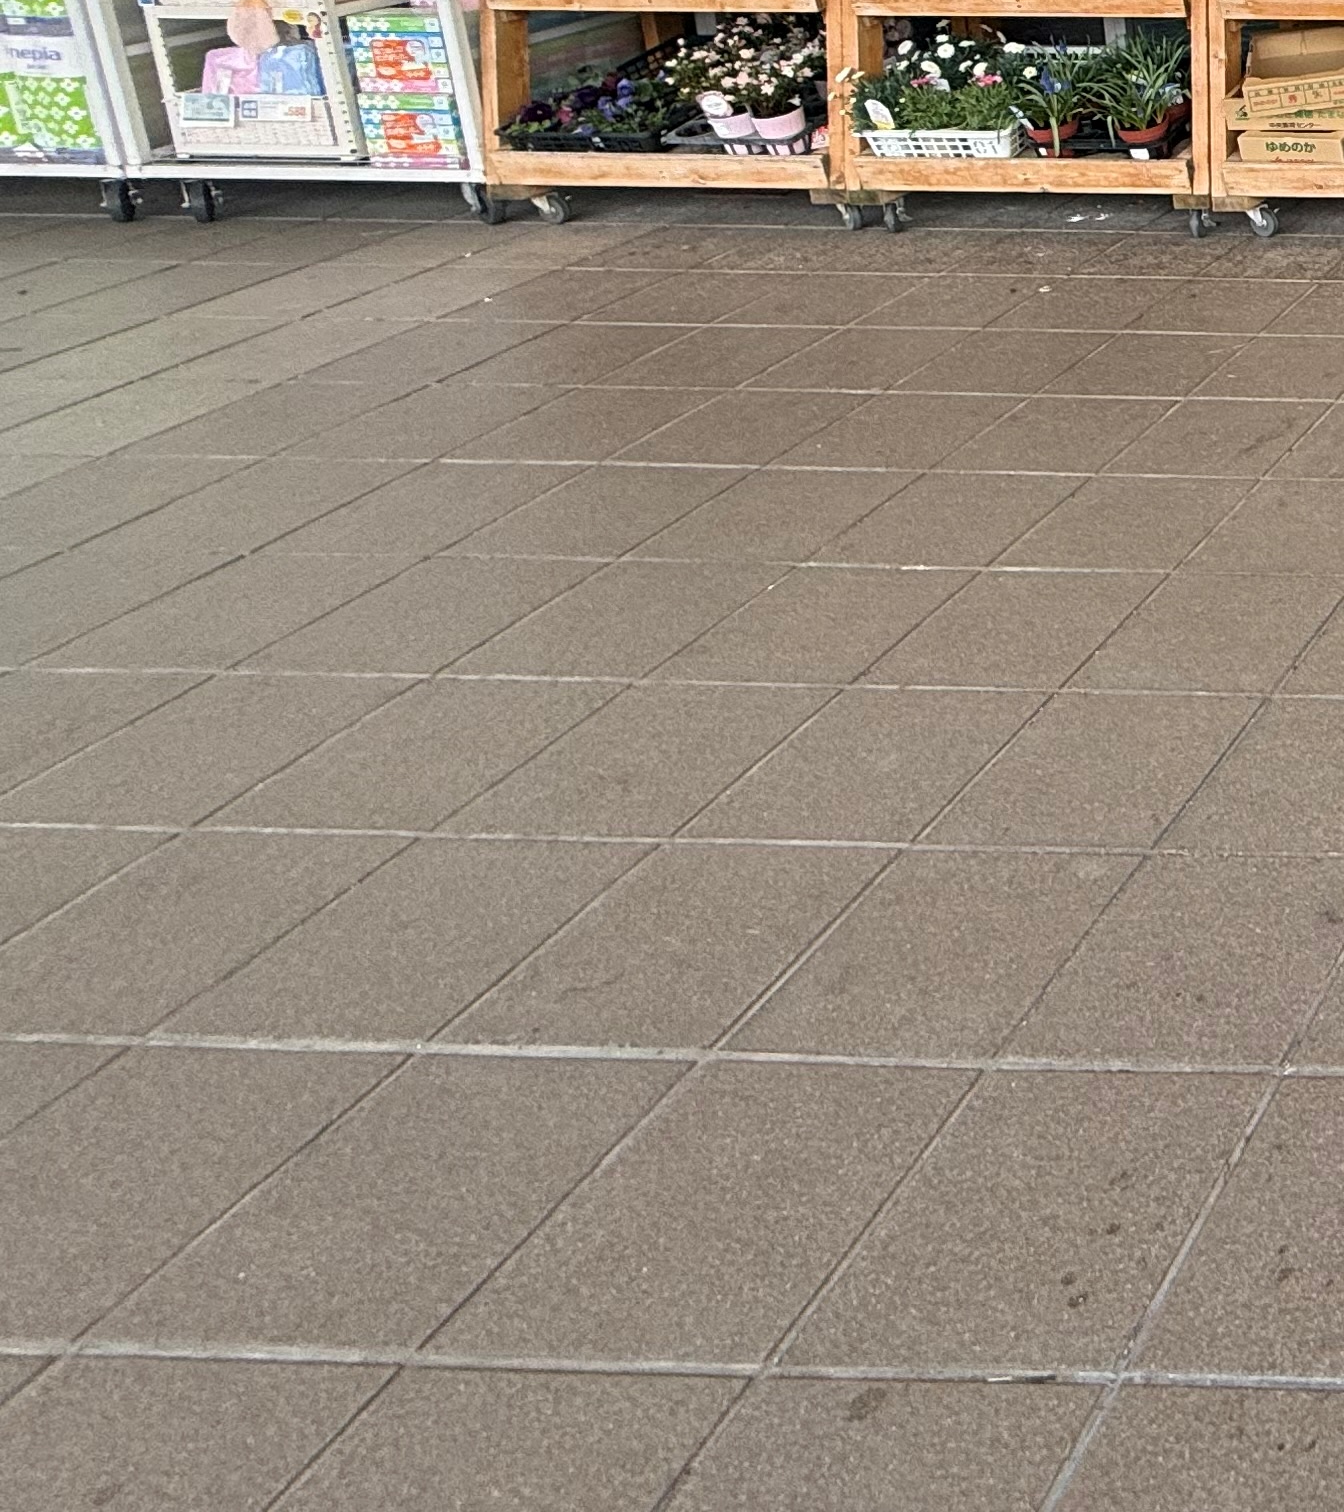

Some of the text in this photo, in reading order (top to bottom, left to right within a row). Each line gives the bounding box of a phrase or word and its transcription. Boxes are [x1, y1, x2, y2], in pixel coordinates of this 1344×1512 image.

[9, 46, 62, 62] nepia
[1265, 141, 1316, 153] ゆめのか
